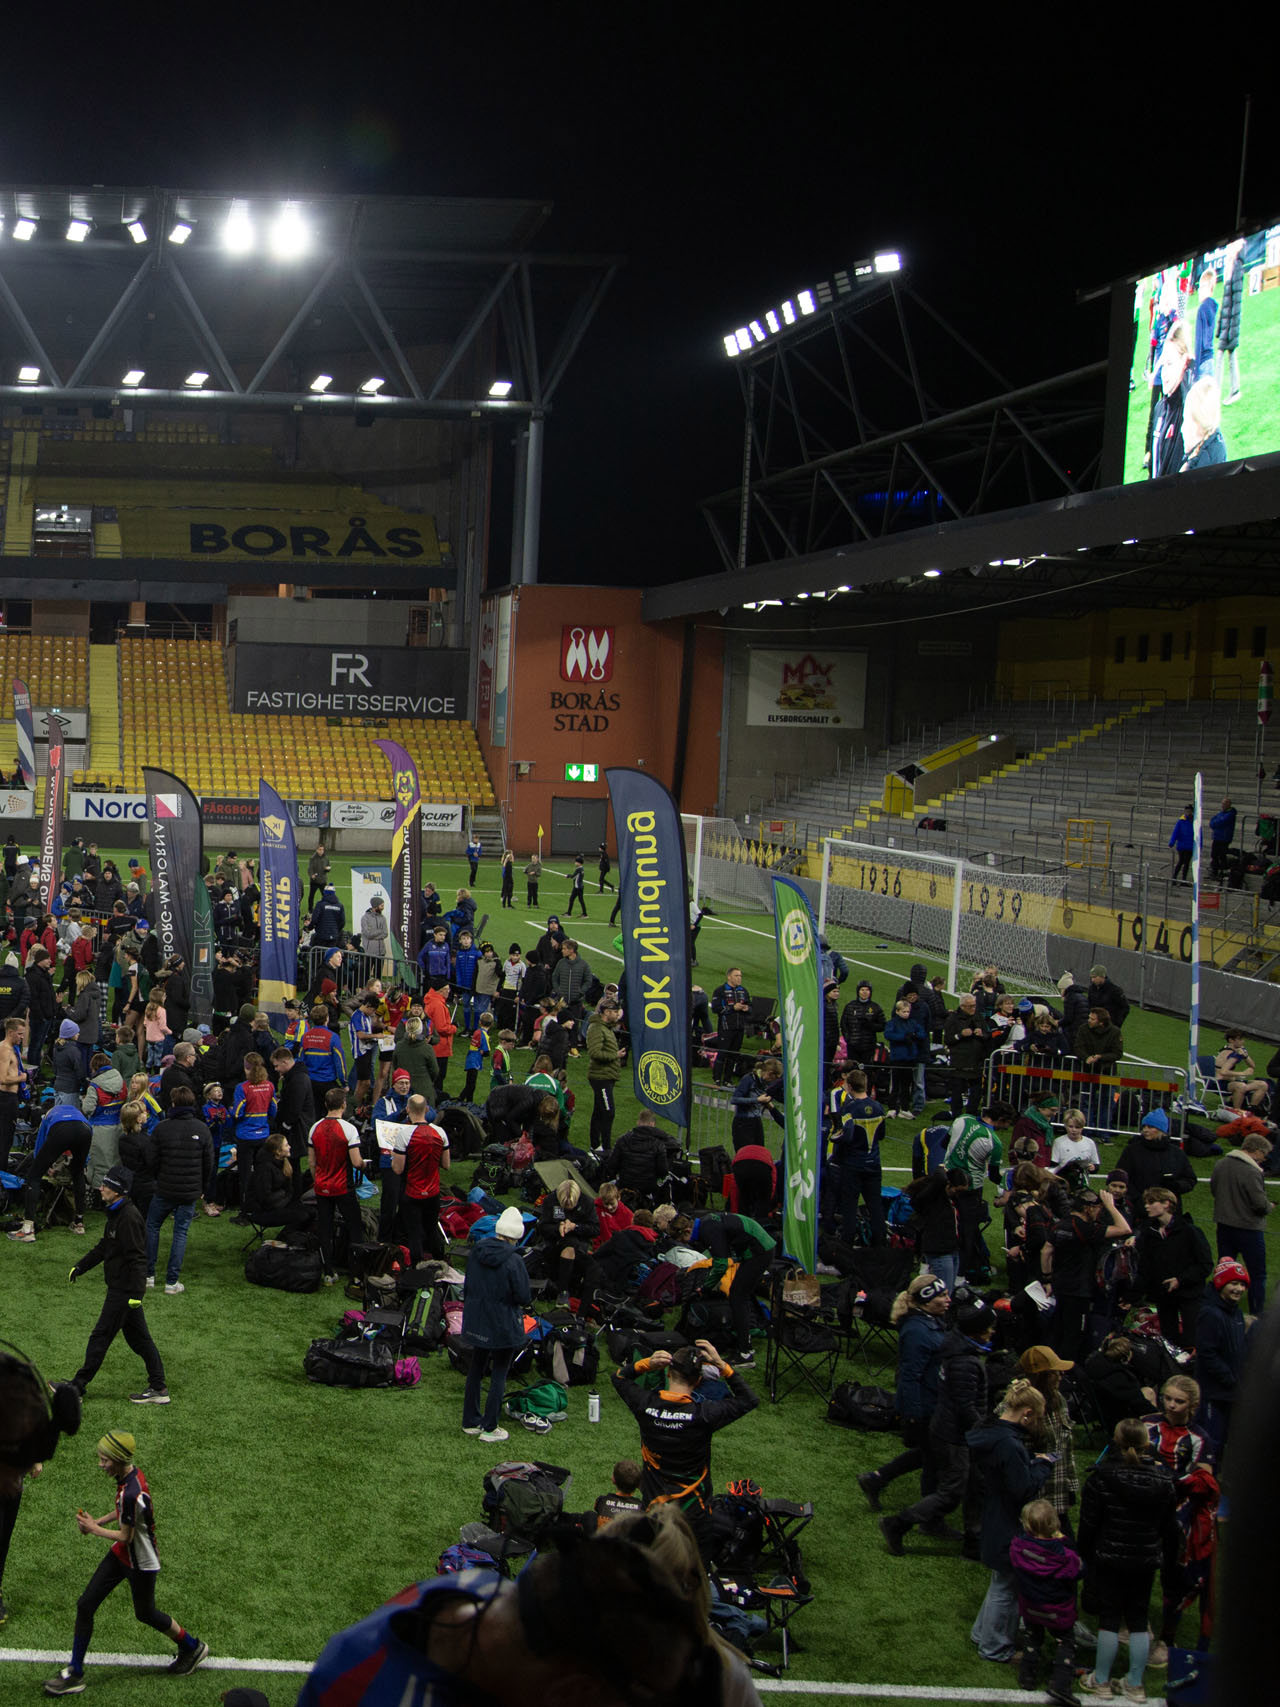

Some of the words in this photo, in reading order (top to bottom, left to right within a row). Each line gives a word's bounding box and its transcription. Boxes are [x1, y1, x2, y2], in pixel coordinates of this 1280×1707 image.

[189, 517, 424, 558] BORÅS
[330, 652, 373, 688] FR
[247, 691, 455, 714] FASTIGHETSSERVICE
[550, 689, 620, 711] BORÅS
[554, 714, 609, 732] STAD
[203, 802, 260, 814] FÄRGBOLA
[420, 813, 458, 821] RCURY
[860, 865, 902, 898] 1936
[968, 883, 1023, 923] 1939
[1117, 912, 1193, 963] 1940
[645, 1407, 657, 1418] OK
[605, 1499, 616, 1507] OK
